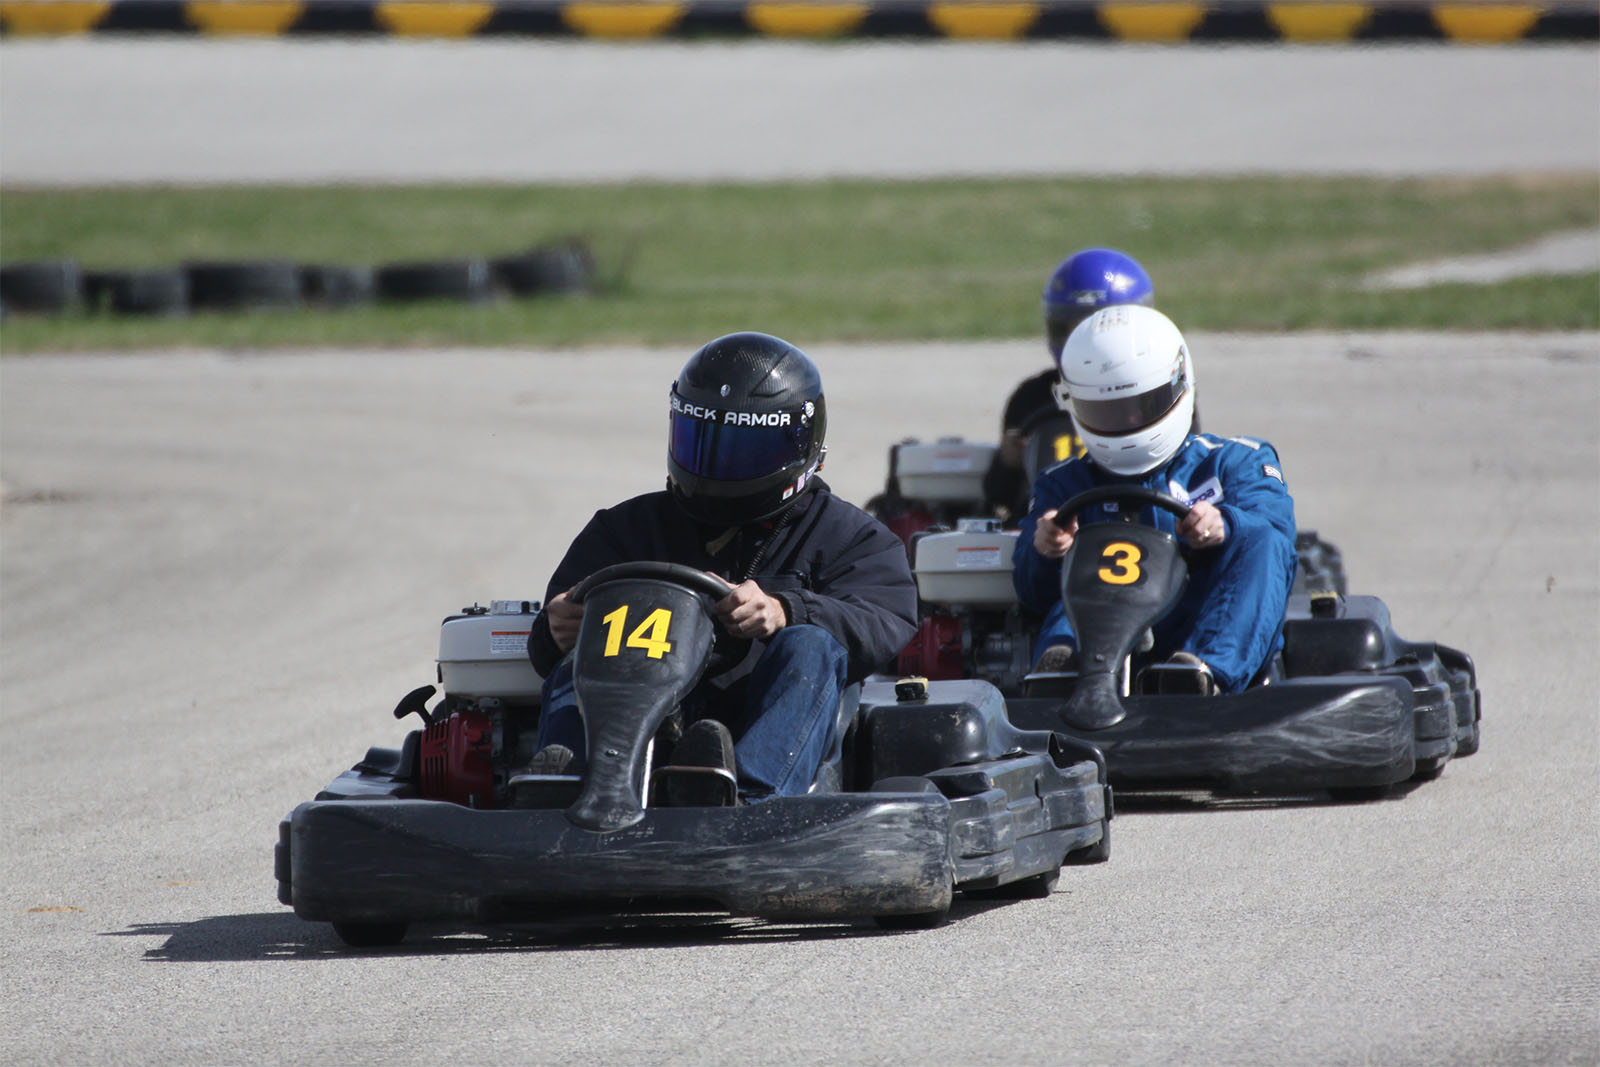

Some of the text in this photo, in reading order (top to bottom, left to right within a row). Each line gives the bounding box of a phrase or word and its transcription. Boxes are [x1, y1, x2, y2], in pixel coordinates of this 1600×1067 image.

[672, 399, 791, 426] BLACK ARMOR
[1098, 542, 1141, 584] 3
[602, 604, 672, 659] 14
